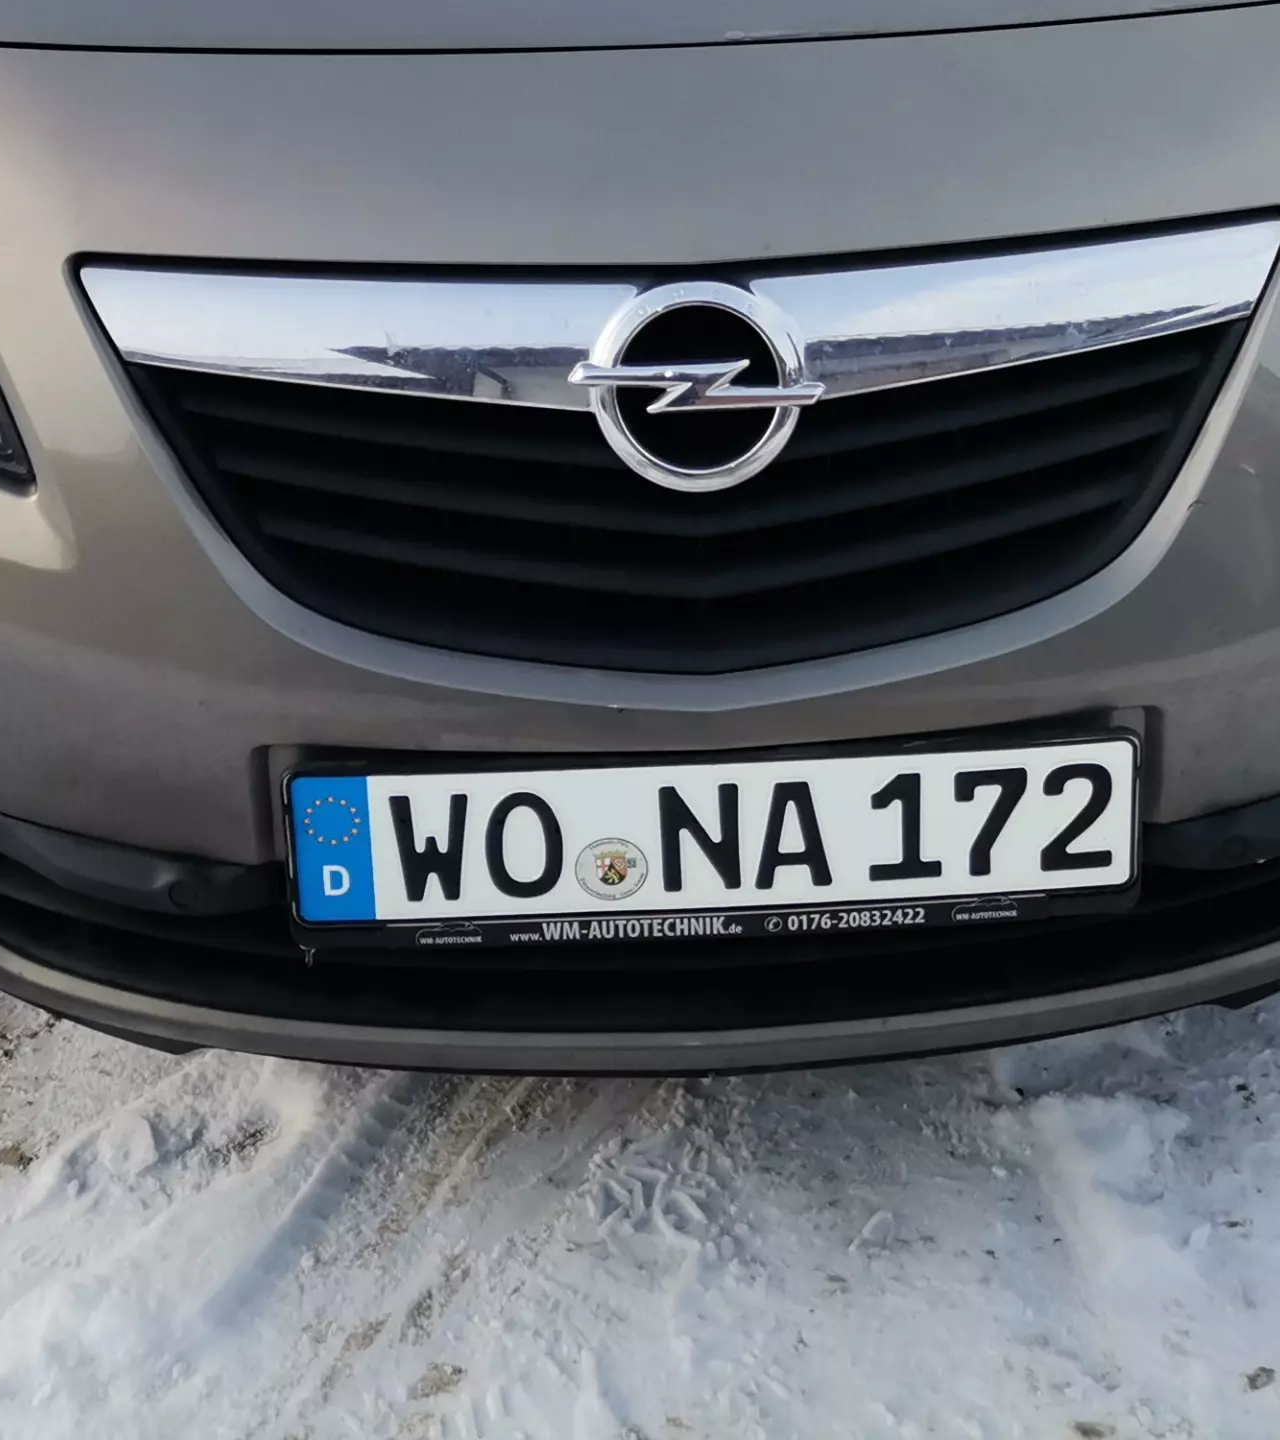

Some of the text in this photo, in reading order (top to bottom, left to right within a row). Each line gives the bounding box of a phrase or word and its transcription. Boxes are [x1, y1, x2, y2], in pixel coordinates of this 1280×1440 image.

[388, 762, 1114, 902] WO NA 172
[322, 865, 351, 896] D
[509, 916, 743, 942] www.WM-AUTOTECHNIK.de
[787, 907, 926, 931] 0176-20832422
